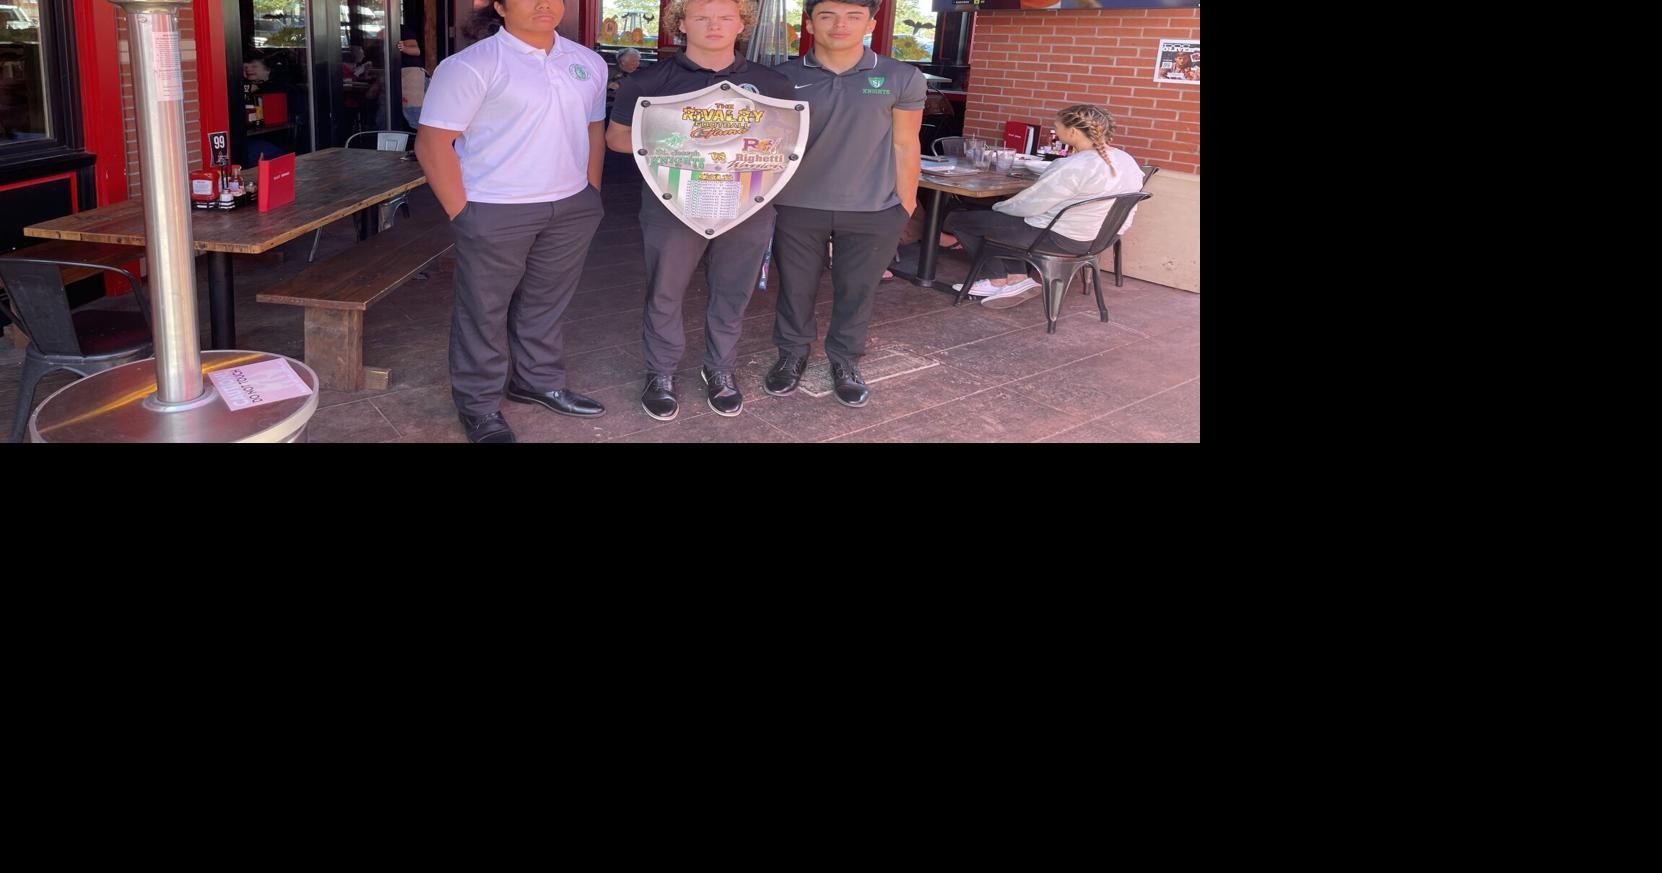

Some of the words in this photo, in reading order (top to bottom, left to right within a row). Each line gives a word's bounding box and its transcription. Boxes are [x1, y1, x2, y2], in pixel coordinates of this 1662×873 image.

[682, 107, 764, 122] RIVALRY
[693, 121, 750, 129] FOOTBALL
[213, 135, 225, 149] 99
[649, 156, 705, 170] KNIGHTS
[735, 153, 783, 163] Righetti
[231, 368, 248, 384] TOUCH
[240, 383, 255, 395] NOT
[249, 394, 263, 403] DO
